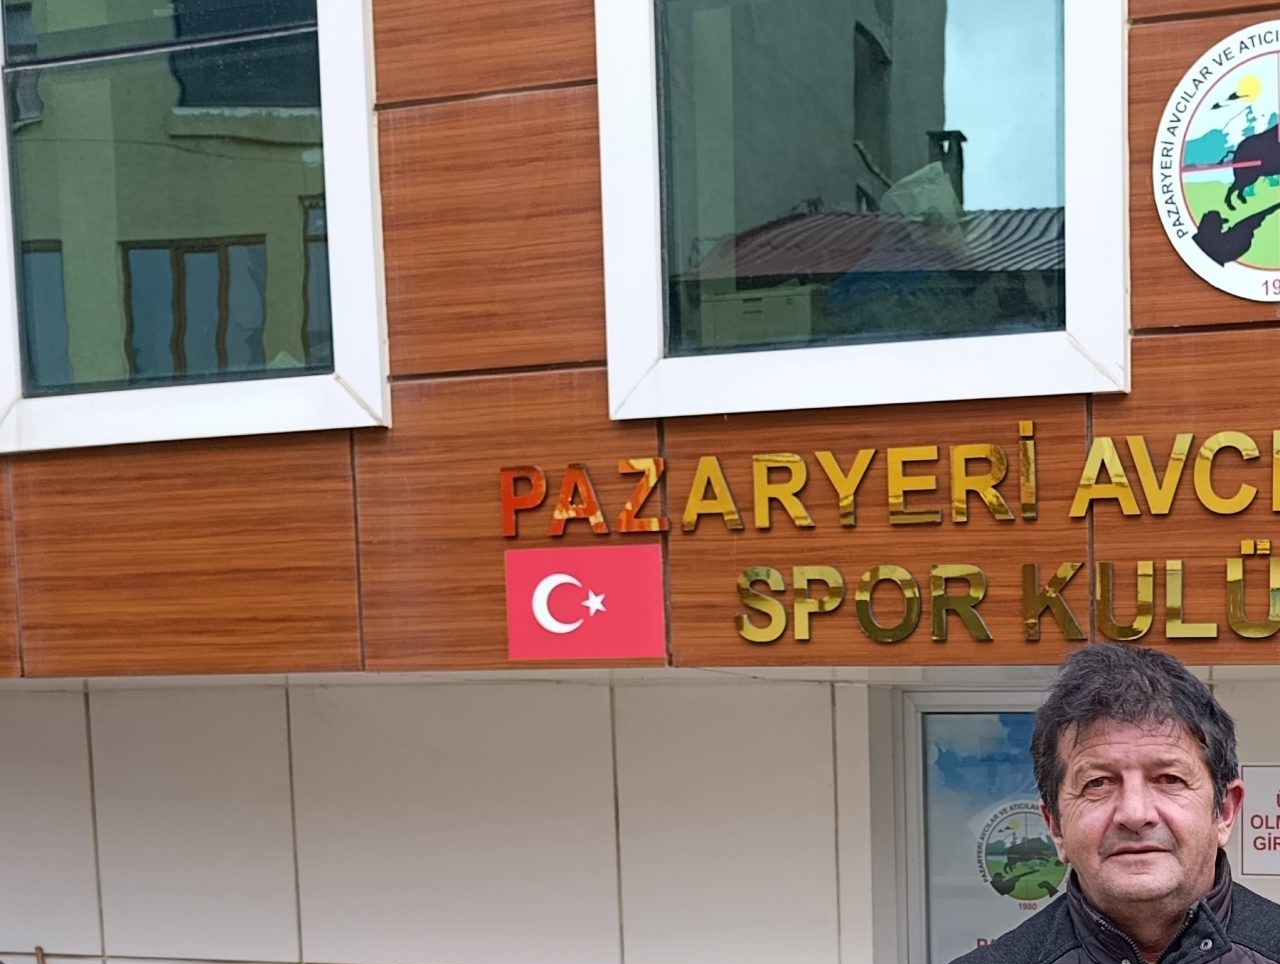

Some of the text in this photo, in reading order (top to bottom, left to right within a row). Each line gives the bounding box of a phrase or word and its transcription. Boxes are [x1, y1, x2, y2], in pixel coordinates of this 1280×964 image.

[1166, 66, 1213, 137] AVCILAR
[1212, 47, 1235, 66] VE
[500, 421, 1038, 537] PAZARYERİ
[735, 564, 993, 643] SPOR
[1018, 903, 1037, 911] 1980
